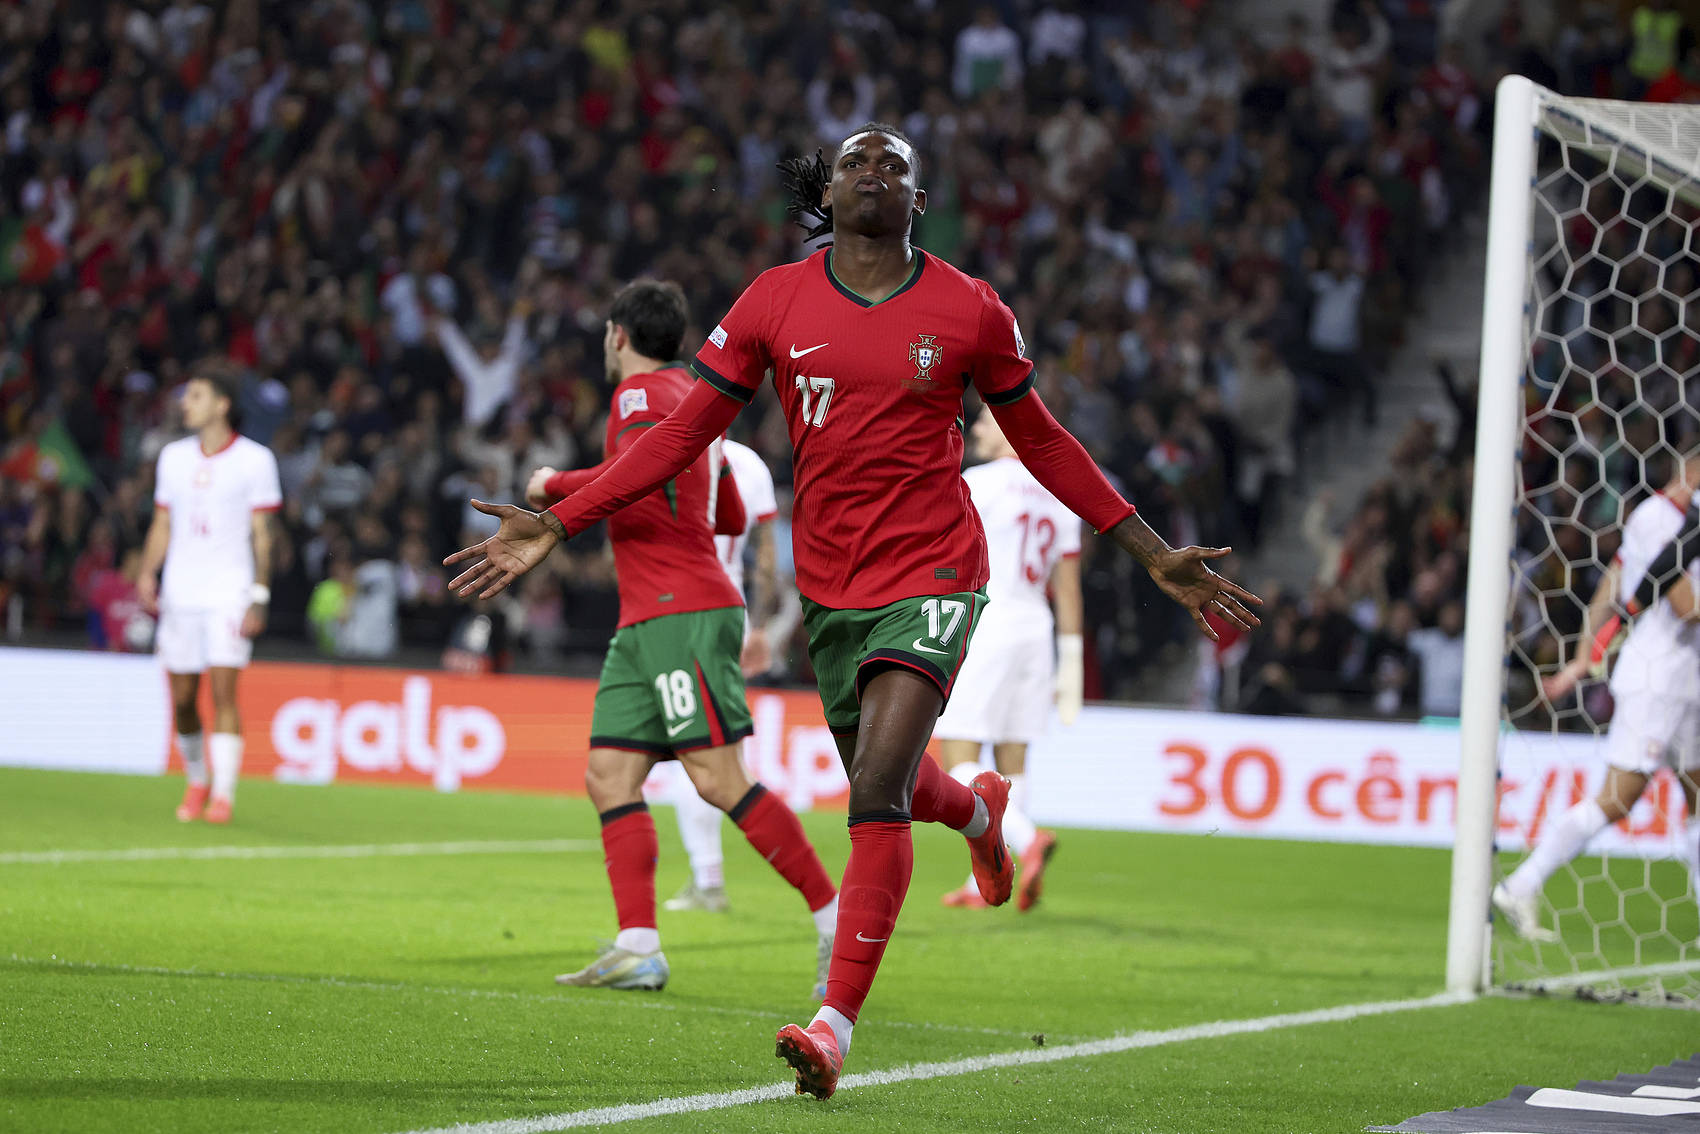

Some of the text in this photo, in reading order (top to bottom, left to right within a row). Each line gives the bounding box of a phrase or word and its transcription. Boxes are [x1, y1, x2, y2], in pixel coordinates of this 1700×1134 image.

[795, 374, 835, 428] 17
[1014, 511, 1056, 585] 13
[921, 598, 967, 647] 17
[655, 669, 697, 720] 18
[270, 676, 508, 793] galp
[1158, 743, 1282, 821] 30
